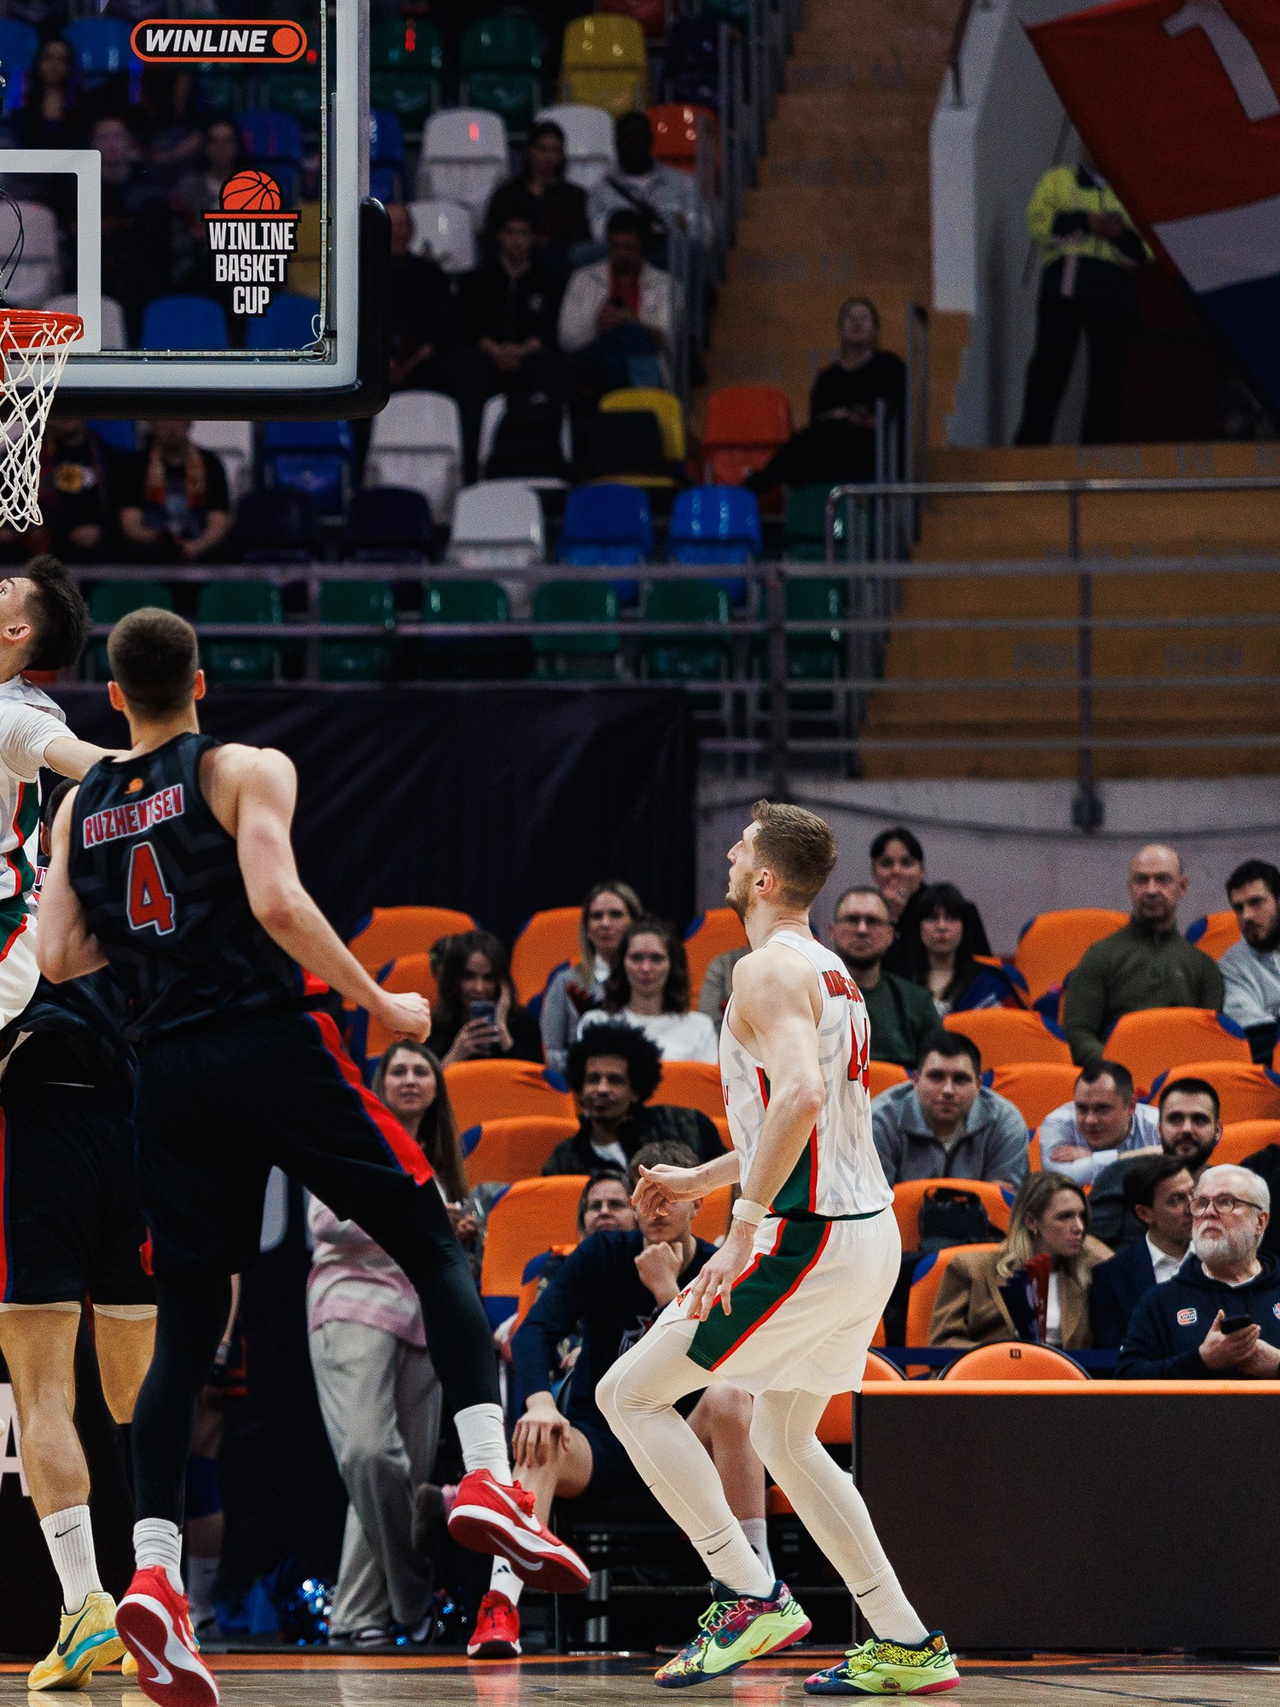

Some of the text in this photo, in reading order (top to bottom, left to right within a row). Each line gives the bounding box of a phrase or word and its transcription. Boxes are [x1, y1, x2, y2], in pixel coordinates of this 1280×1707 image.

[146, 29, 268, 53] WINLINE
[209, 222, 294, 250] WINLINE
[215, 254, 287, 282] BASKET
[233, 286, 270, 314] CUP
[83, 783, 185, 849] RUZHENTSEV
[126, 841, 176, 936] 4
